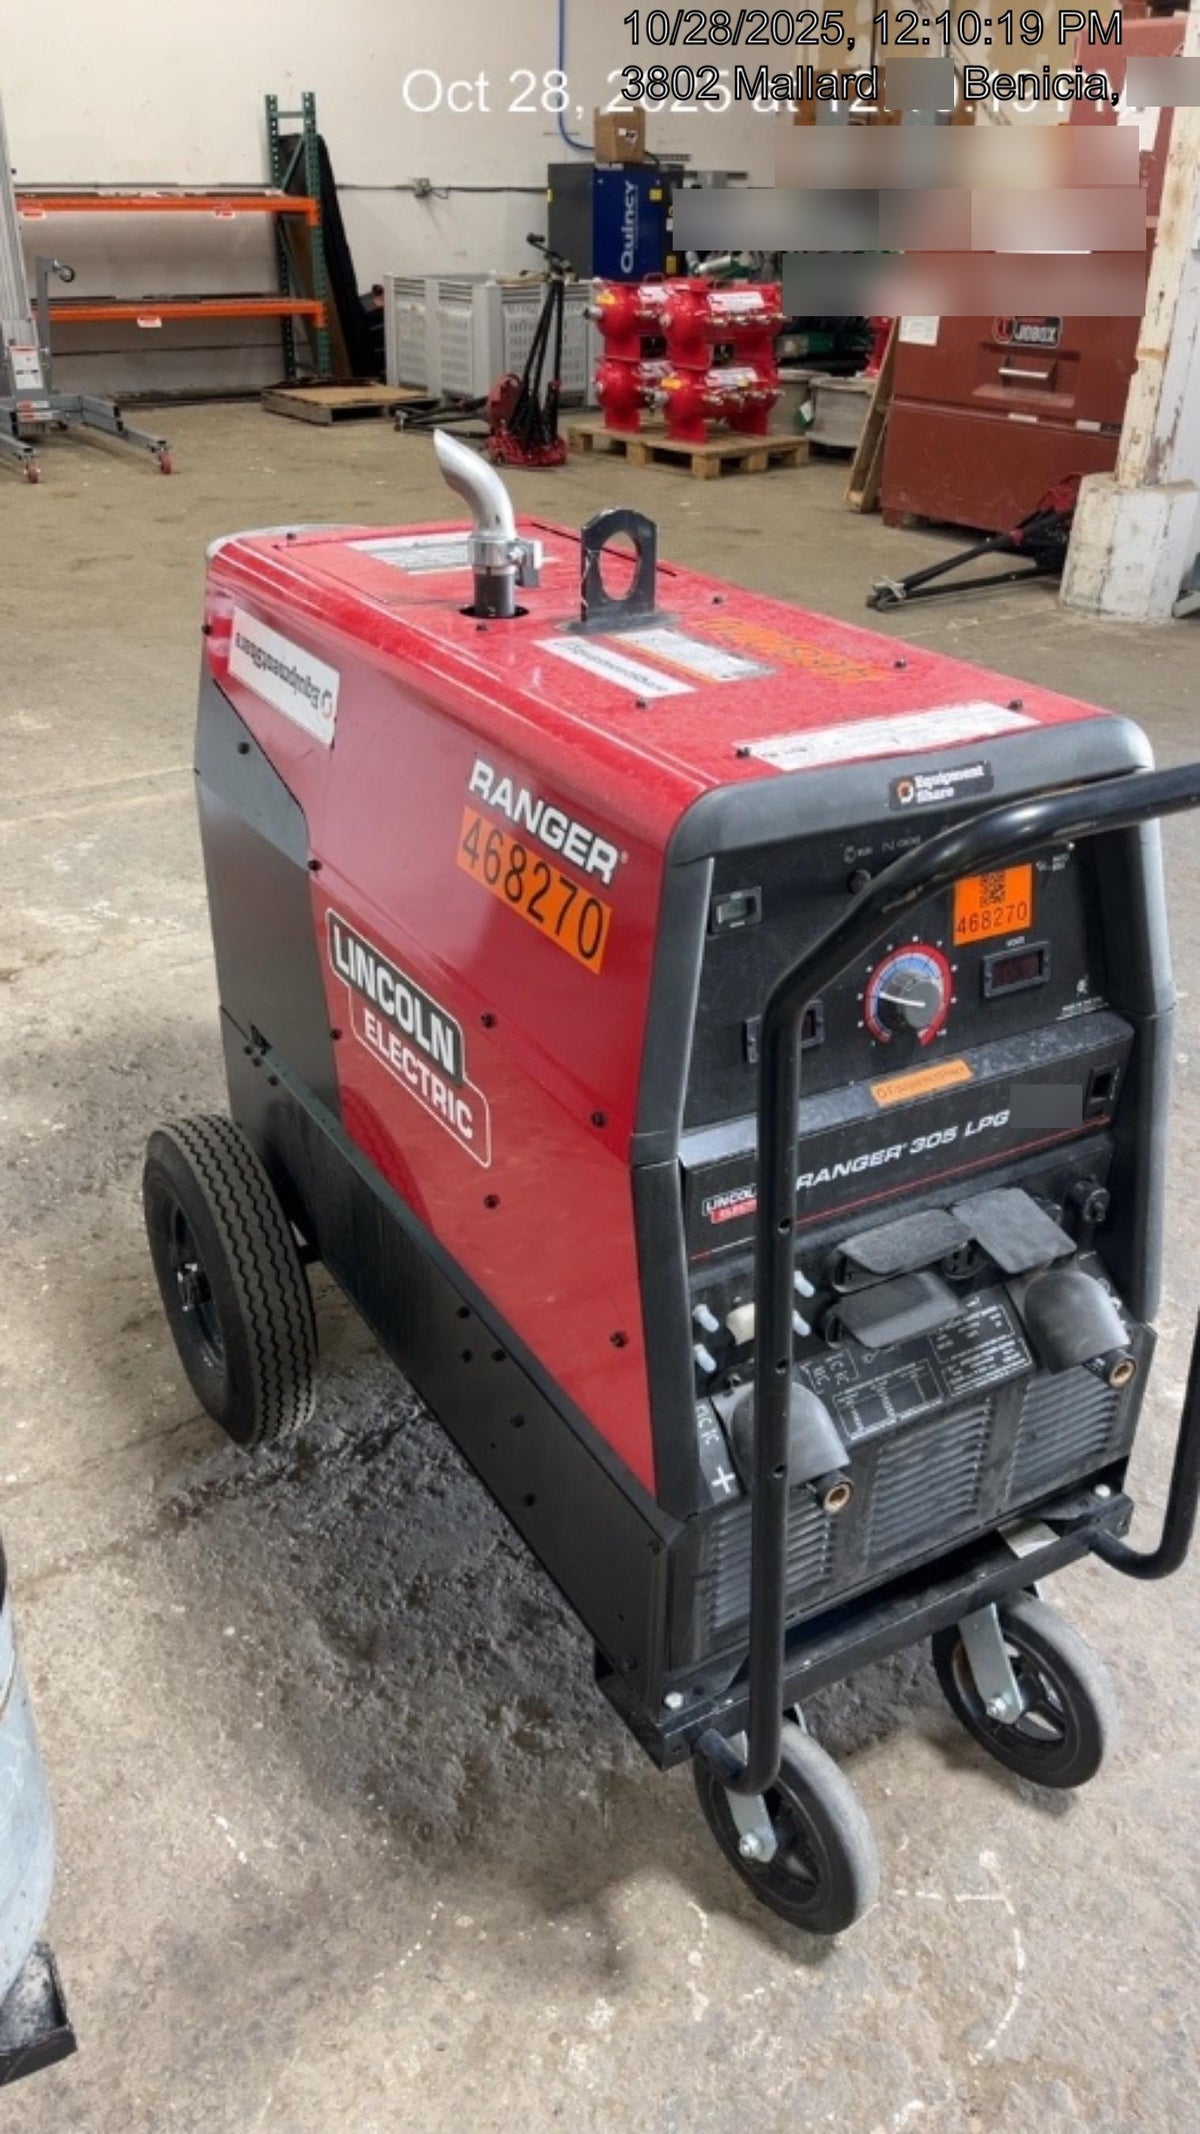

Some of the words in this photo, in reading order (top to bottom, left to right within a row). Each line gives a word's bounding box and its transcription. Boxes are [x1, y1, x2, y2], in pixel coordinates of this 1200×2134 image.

[620, 179, 635, 275] Quincy
[468, 758, 620, 885] RANGER
[461, 816, 604, 961] 468270
[957, 900, 1028, 935] 468270
[334, 924, 455, 1076] LINCOLN
[363, 1008, 474, 1141] ELECTRIC
[796, 1143, 903, 1191] RANGER
[909, 1125, 957, 1155] 305
[963, 1109, 1011, 1137] LPG
